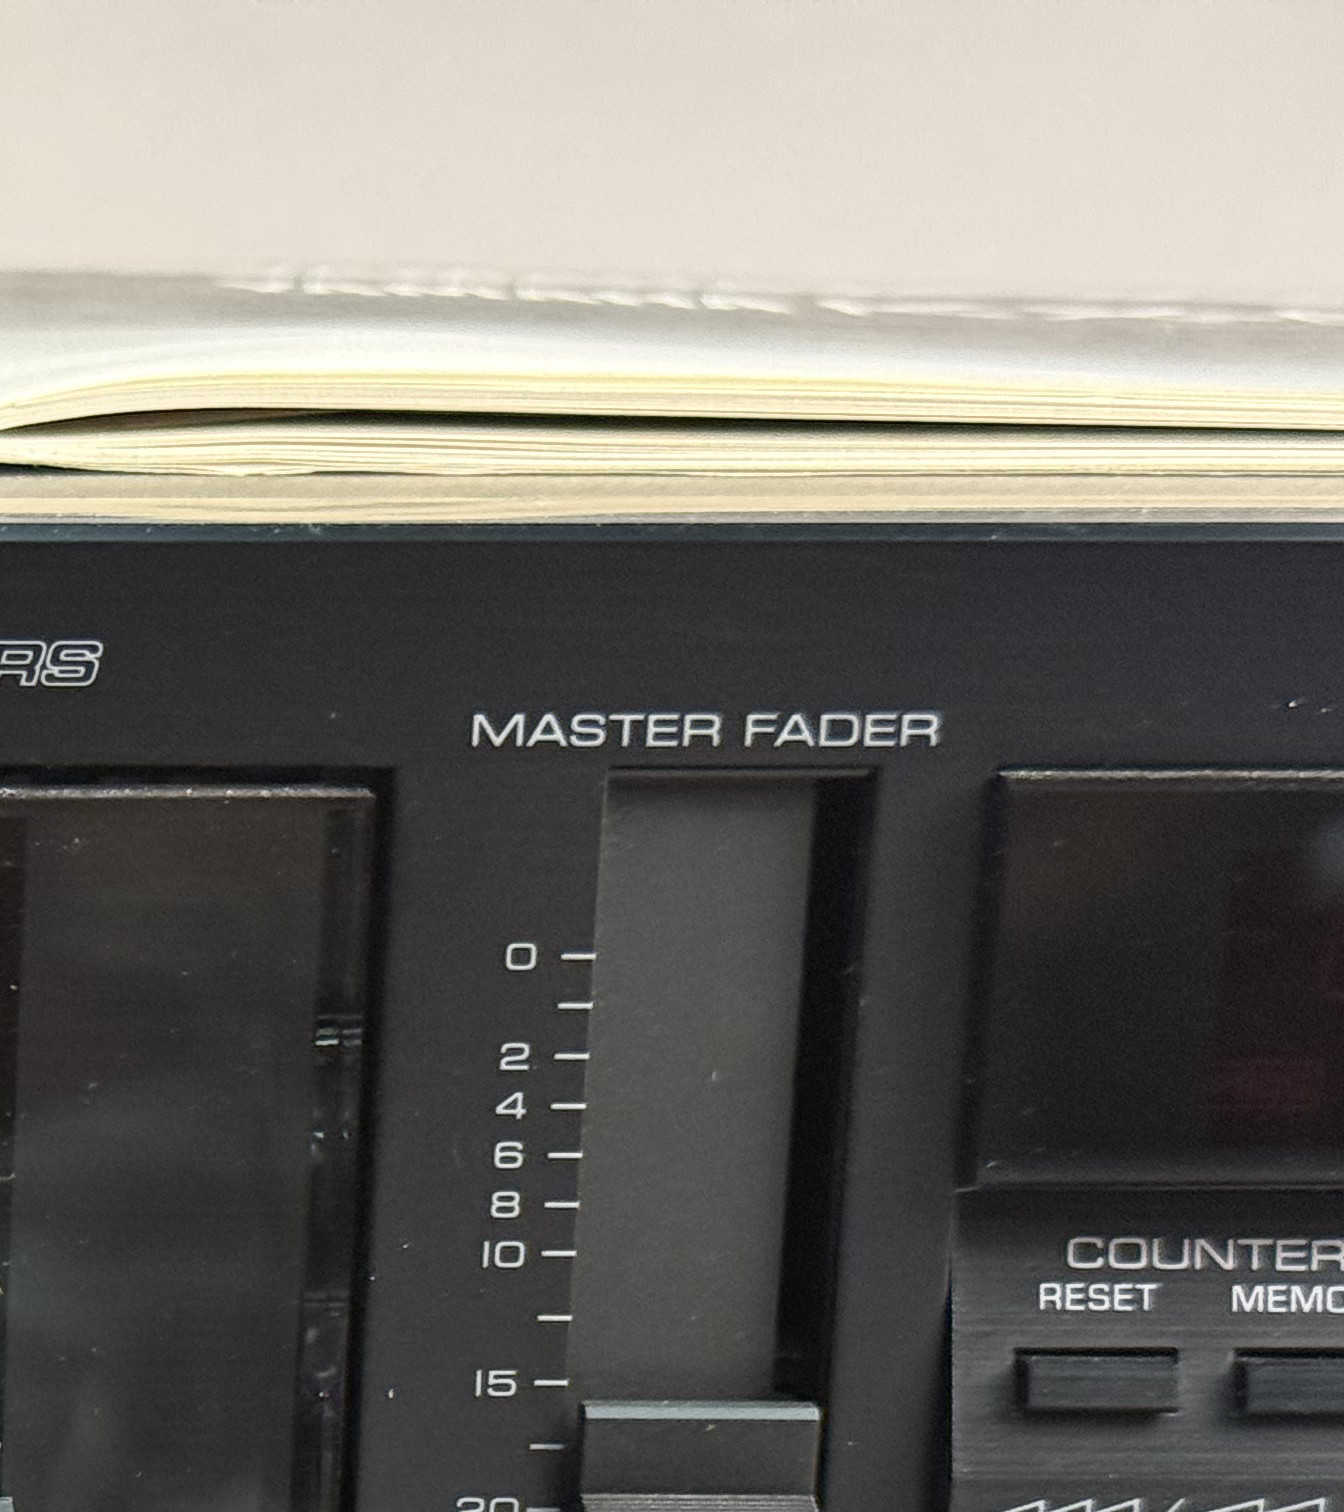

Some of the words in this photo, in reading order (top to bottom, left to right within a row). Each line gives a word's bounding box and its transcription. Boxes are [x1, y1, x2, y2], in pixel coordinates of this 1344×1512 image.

[471, 712, 722, 747] MASTER
[744, 712, 941, 747] FADER
[505, 942, 538, 971] 0
[499, 1042, 530, 1071] 2
[495, 1091, 527, 1120] 4
[493, 1141, 524, 1169] 6
[490, 1190, 521, 1219] 8
[482, 1240, 526, 1269] 10
[1067, 1237, 1344, 1272] COUNTER
[1039, 1282, 1159, 1312] RESET
[475, 1369, 517, 1397] 15
